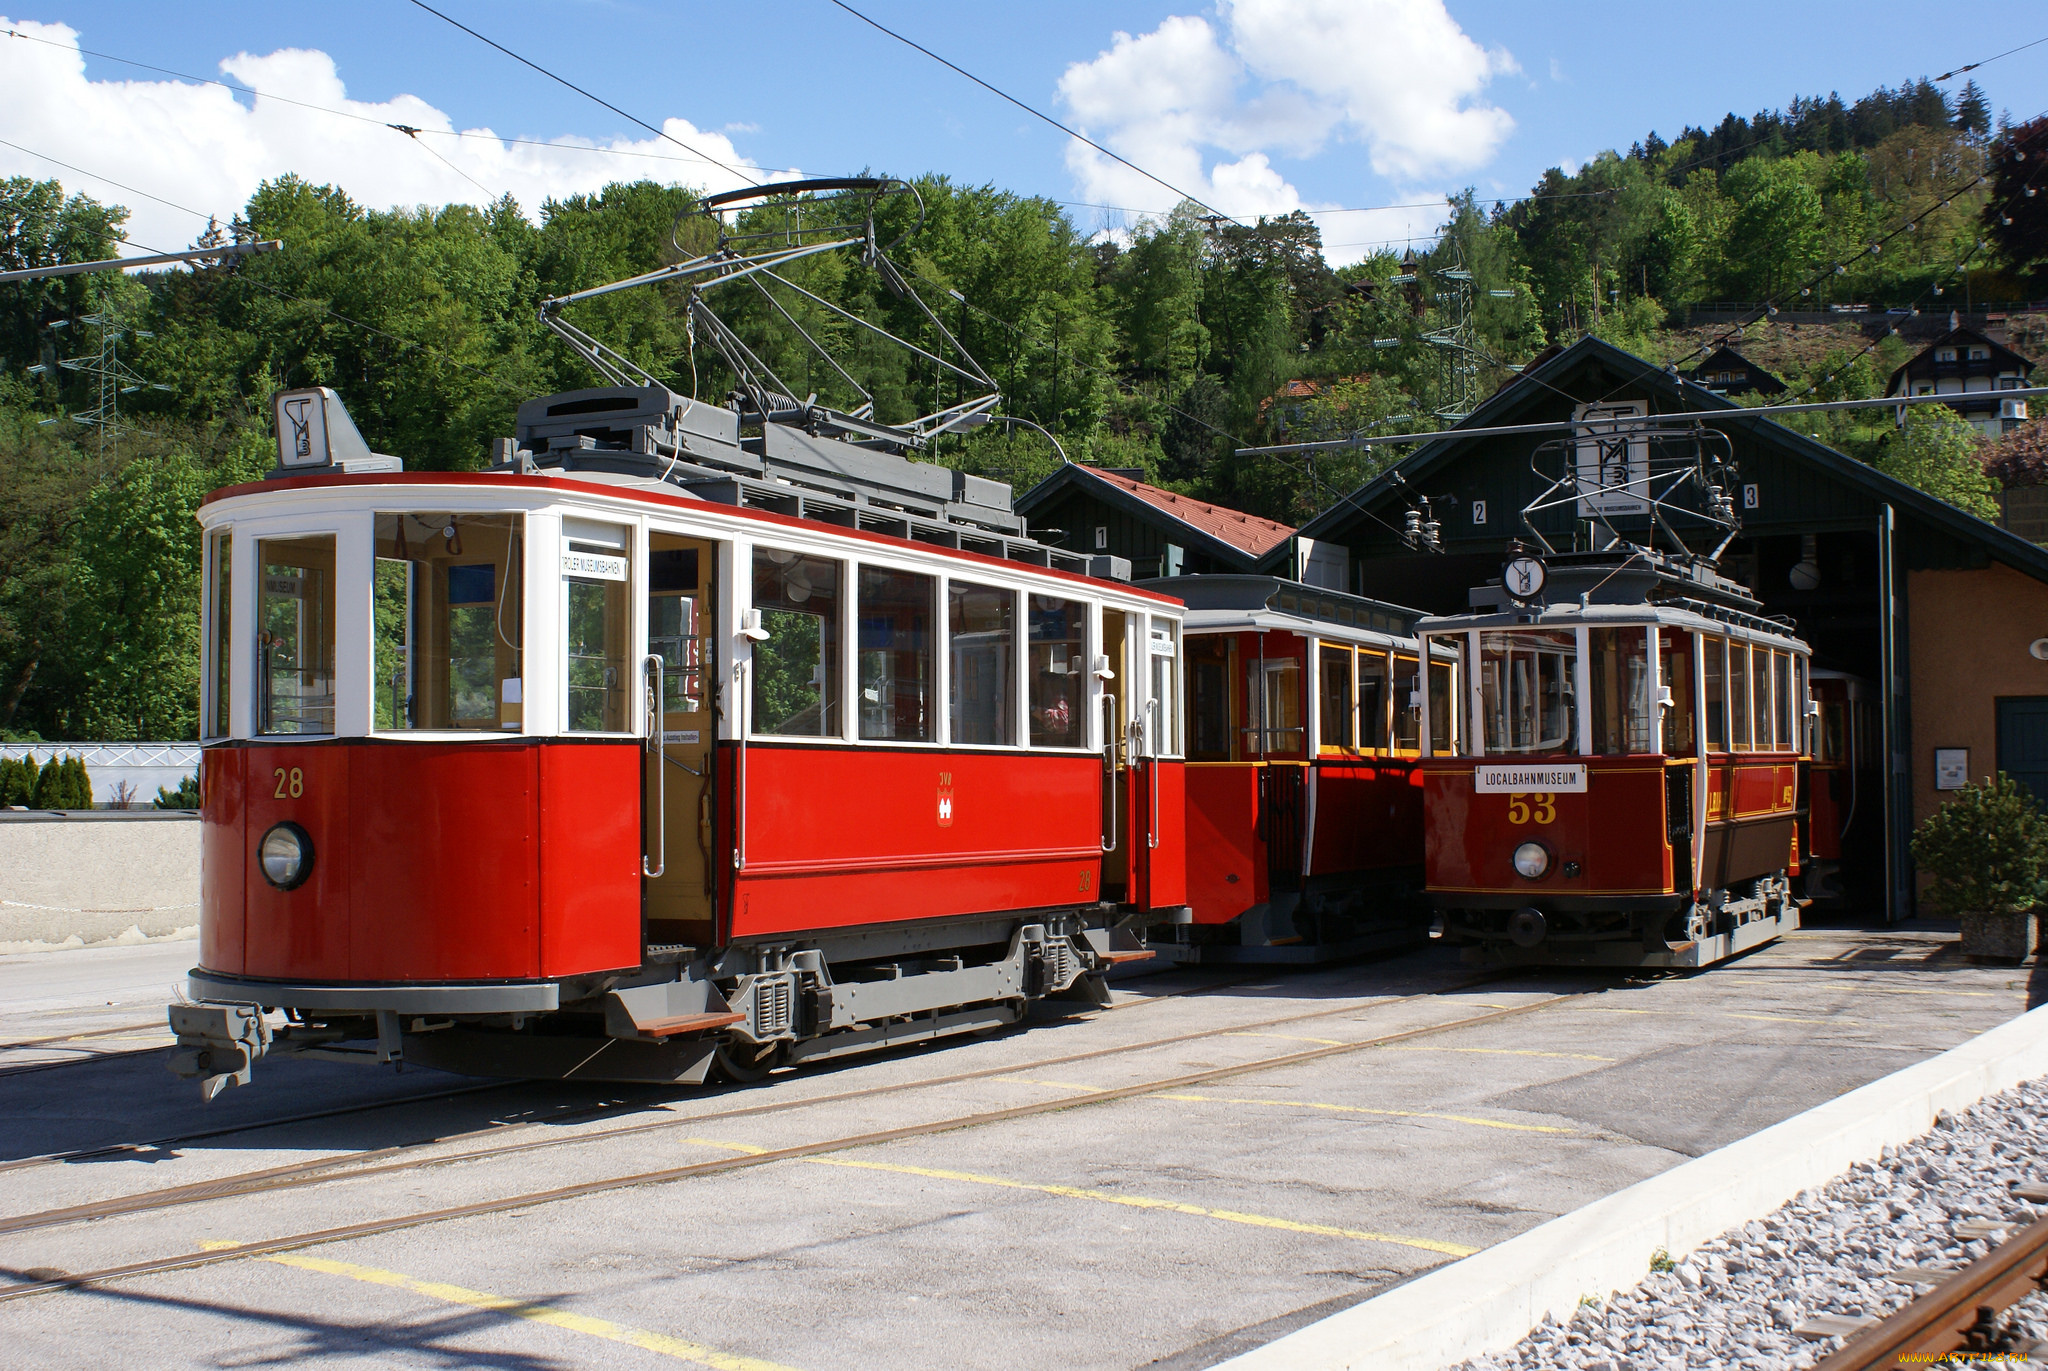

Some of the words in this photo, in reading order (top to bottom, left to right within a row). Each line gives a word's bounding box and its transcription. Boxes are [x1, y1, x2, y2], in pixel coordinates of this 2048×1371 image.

[1746, 486, 1756, 506] 3
[1475, 503, 1484, 522] 2
[1098, 528, 1105, 547] 1
[273, 766, 304, 799] 28
[1485, 772, 1576, 786] LOCALBAHNMUSEUM
[1508, 792, 1557, 825] 53
[1078, 870, 1091, 892] 28
